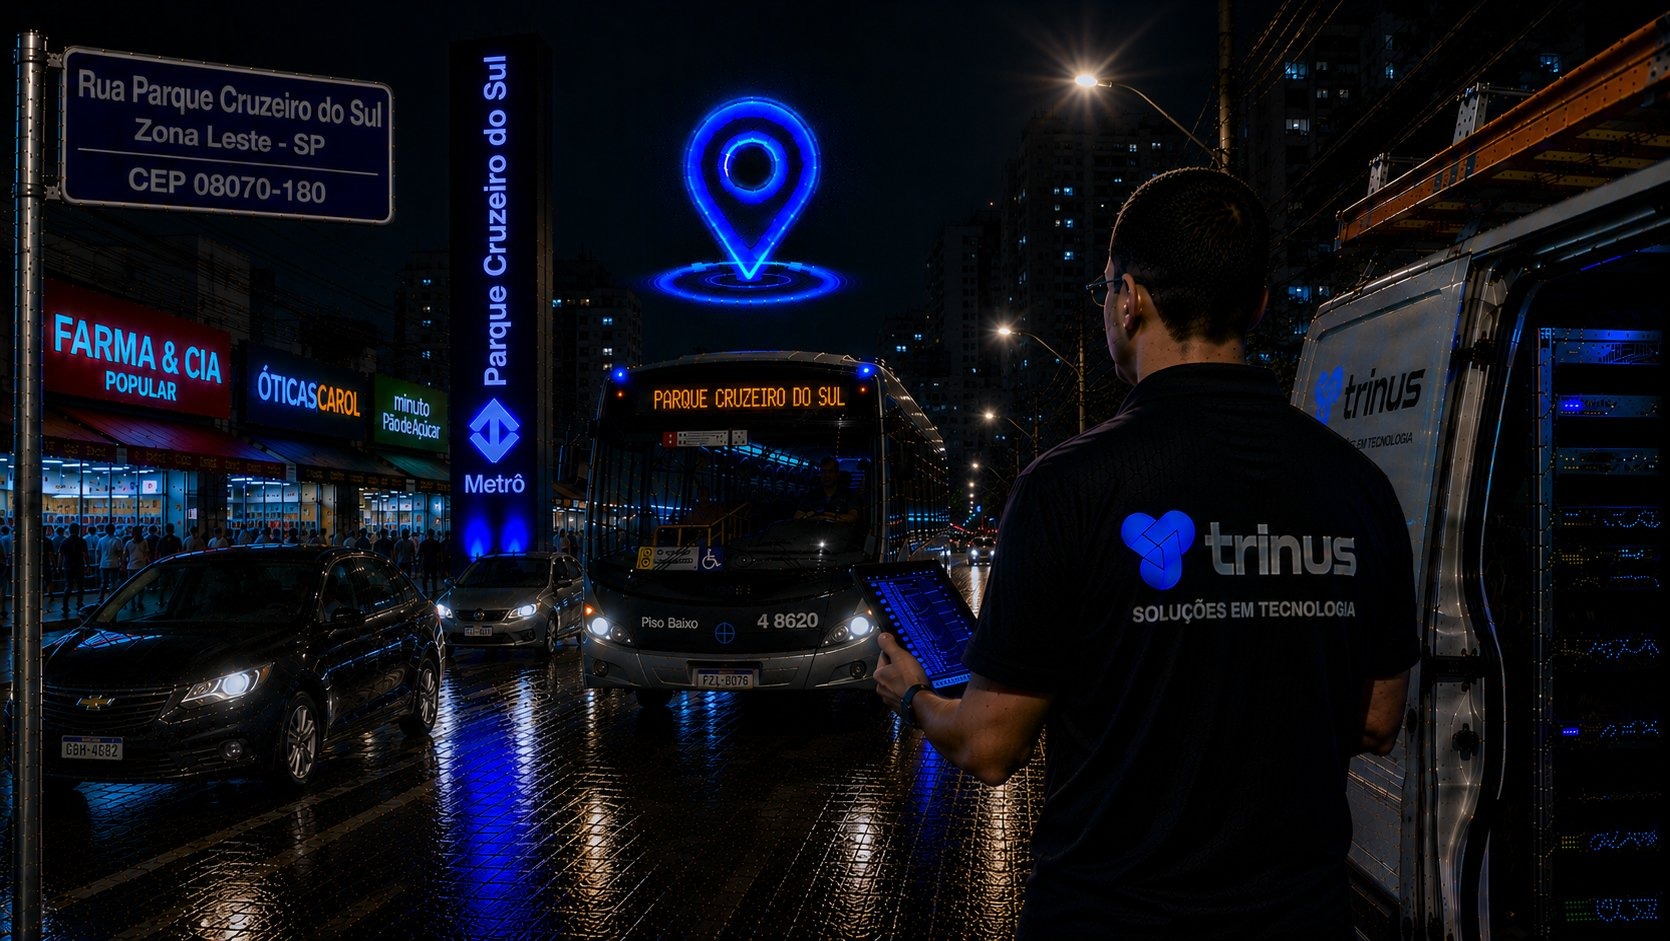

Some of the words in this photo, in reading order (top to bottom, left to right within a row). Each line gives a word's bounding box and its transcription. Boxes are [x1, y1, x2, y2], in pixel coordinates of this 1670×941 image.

[483, 55, 507, 100] Sul
[78, 68, 126, 101] Rua
[132, 74, 214, 116] Parque
[219, 84, 312, 121] Cruzeiro
[317, 95, 345, 125] do
[350, 98, 383, 128] Sul
[133, 117, 200, 147] Zona
[207, 124, 272, 153] Leste
[293, 132, 326, 156] SP
[483, 109, 507, 146] do
[127, 166, 187, 194] CEP
[193, 172, 327, 204] 08070-180
[483, 154, 507, 276] Cruzeiro
[54, 313, 157, 370] FARMA
[161, 340, 180, 375] &
[184, 346, 223, 384] CIA
[483, 285, 512, 386] Parque
[105, 370, 177, 401] POPULAR
[653, 388, 708, 410] PARQUE
[715, 387, 786, 408] CRUZEIRO
[792, 386, 811, 407] DO
[818, 386, 846, 407] SUL
[1343, 367, 1426, 420] trinus
[393, 393, 430, 418] minuto
[1367, 431, 1413, 449] TECNOLOGIA
[464, 474, 526, 494] Metrô
[1204, 521, 1357, 577] trinus
[641, 616, 665, 629] Piso
[667, 616, 699, 630] Baixo
[756, 613, 769, 629] 4
[773, 612, 819, 629] 8620
[1132, 598, 1227, 625] SOLUÇÕES
[1230, 601, 1254, 618] EM
[1258, 600, 1356, 618] TECNOLOGIA
